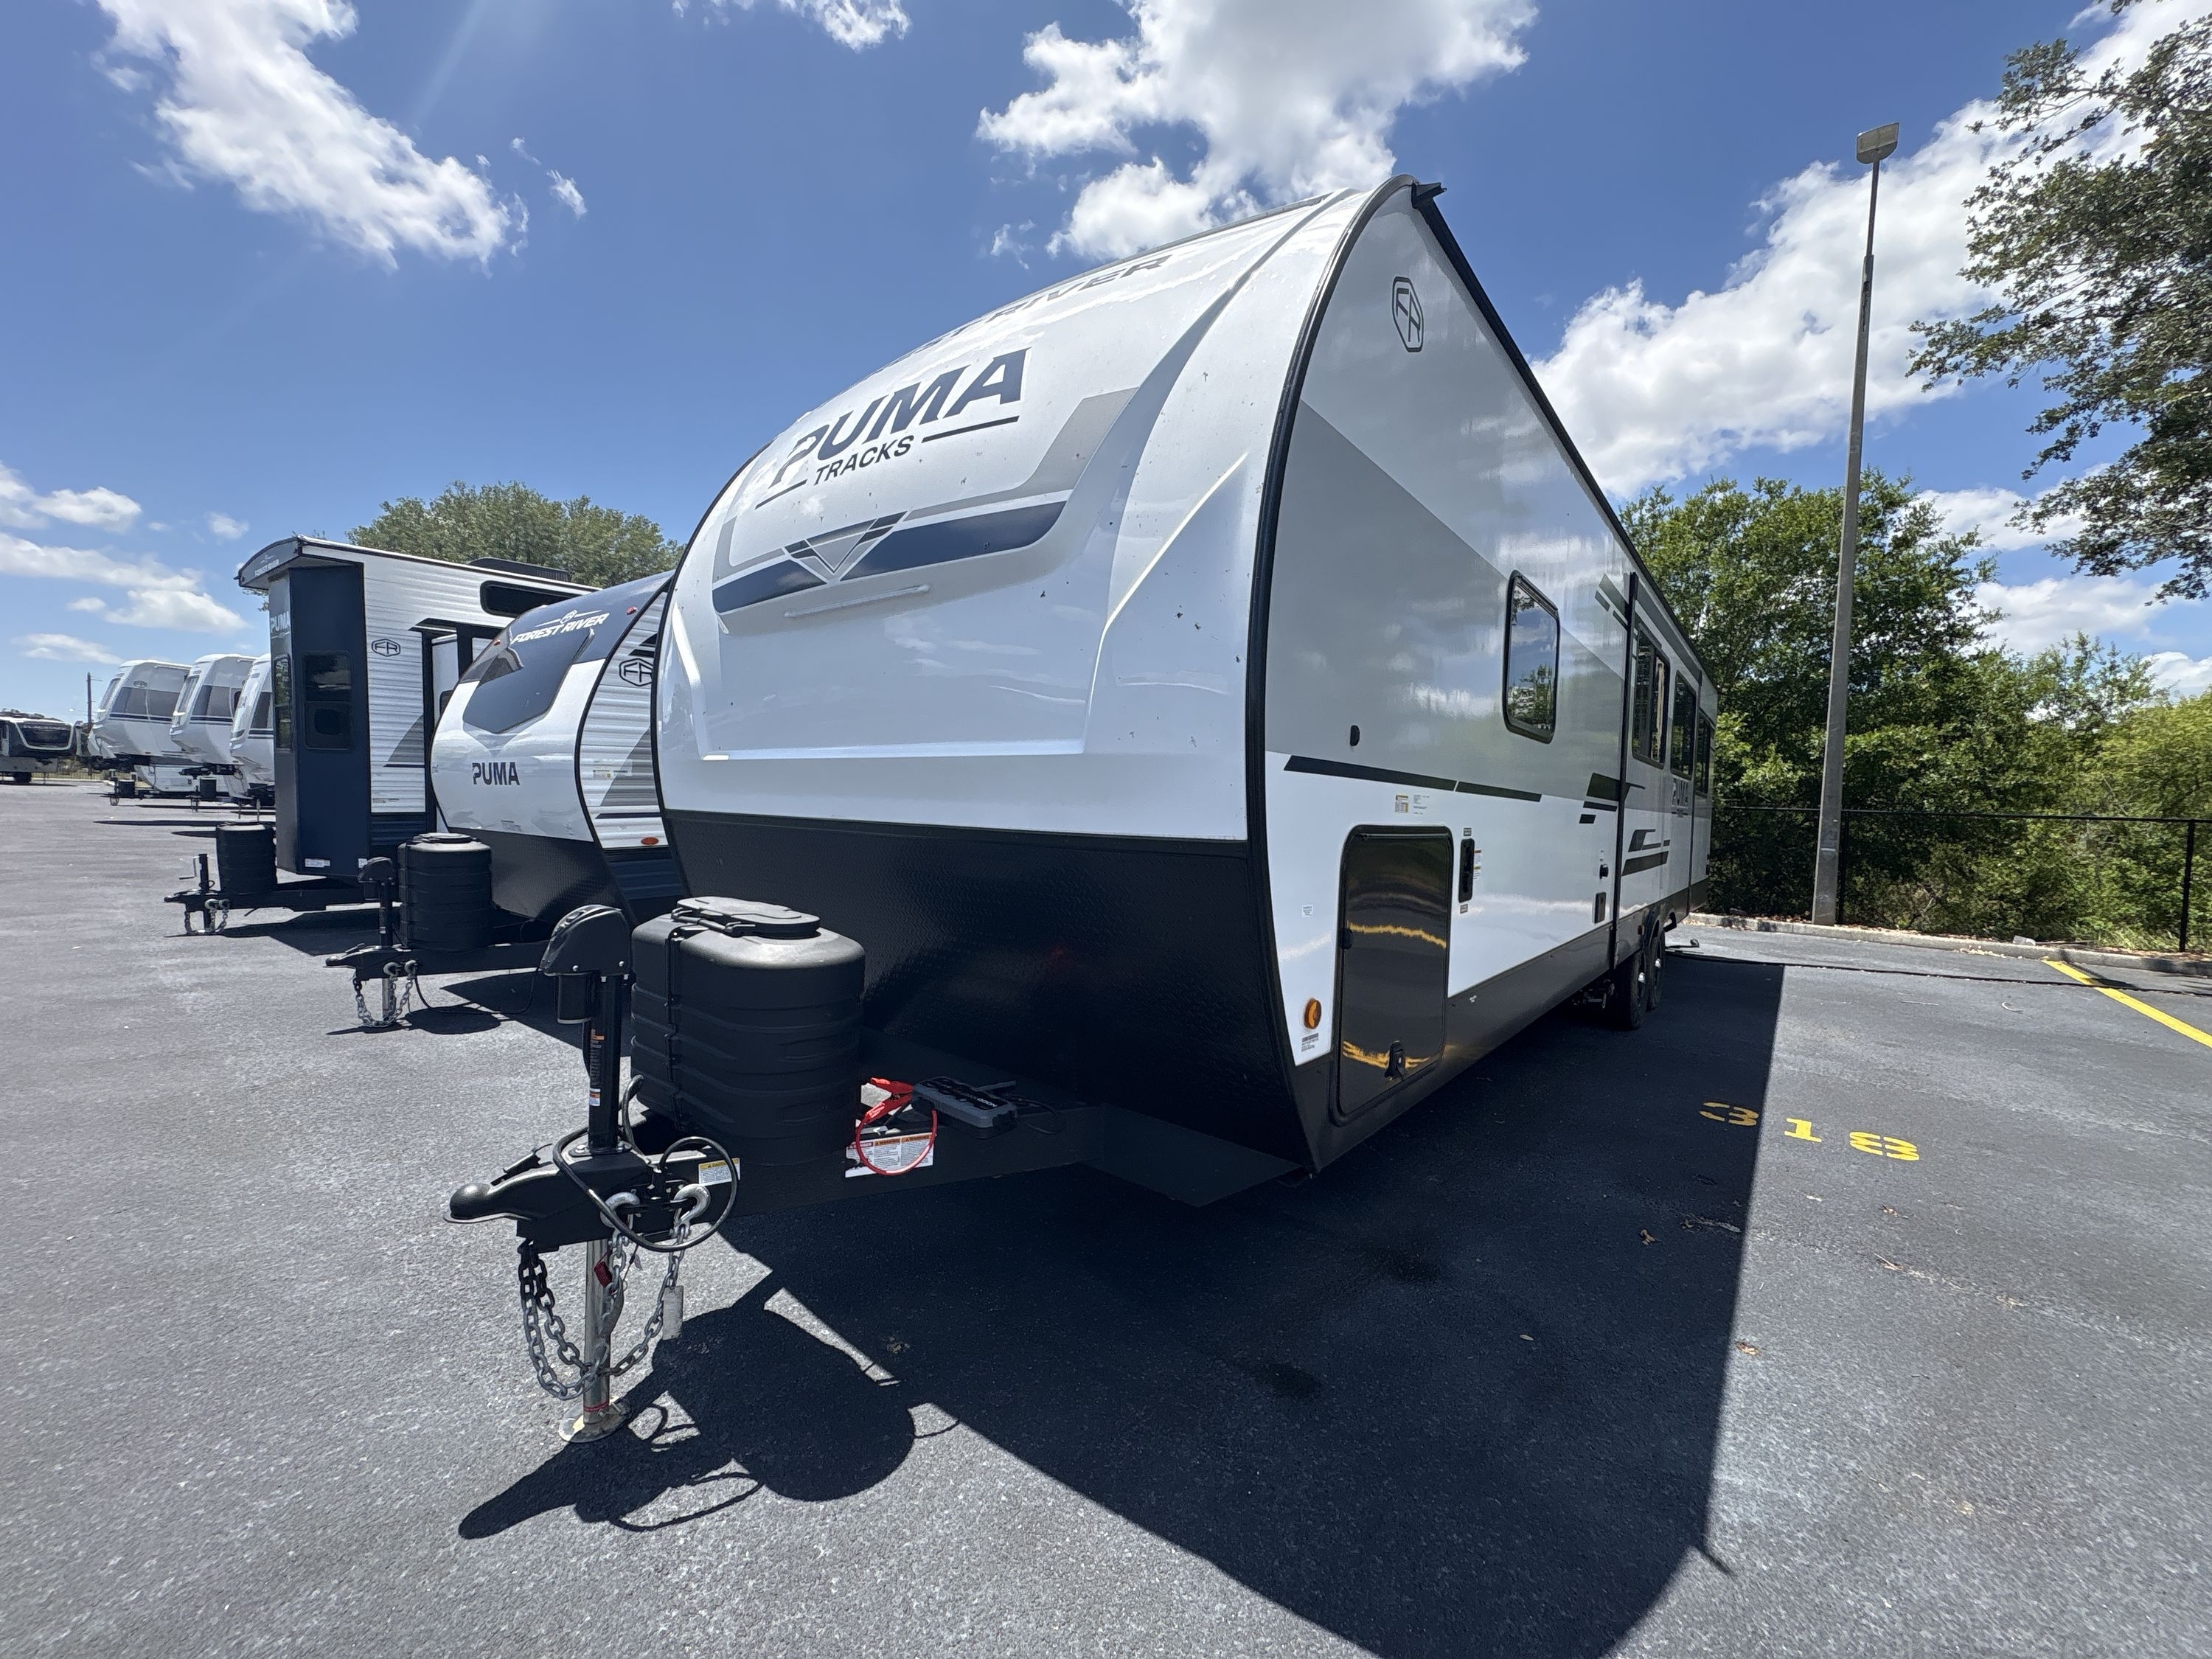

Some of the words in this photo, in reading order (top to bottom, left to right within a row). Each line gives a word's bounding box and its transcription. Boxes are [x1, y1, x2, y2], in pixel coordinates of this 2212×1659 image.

[768, 347, 1032, 489] PUMA
[813, 435, 914, 486] TRACKS
[510, 624, 563, 644] FOREST
[560, 613, 611, 633] RIVER
[472, 761, 521, 785] PUMA
[1699, 1101, 1920, 1161] 318
